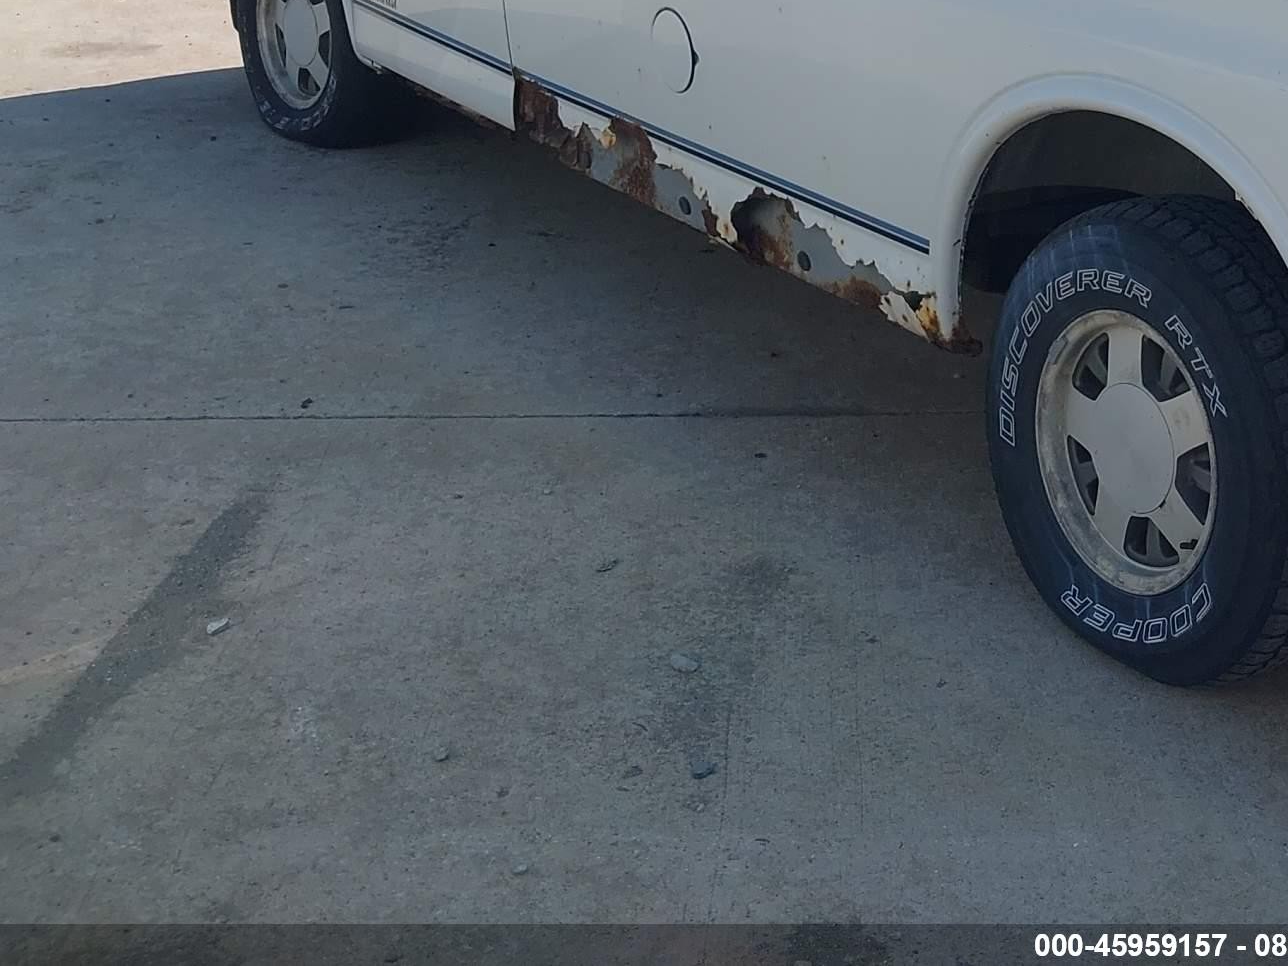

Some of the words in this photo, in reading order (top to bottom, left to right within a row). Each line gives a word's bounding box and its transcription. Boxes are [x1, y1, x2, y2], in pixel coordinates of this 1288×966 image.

[998, 267, 1153, 448] DISCOVERER
[1164, 314, 1229, 420] RTX
[1060, 581, 1213, 645] COOPER
